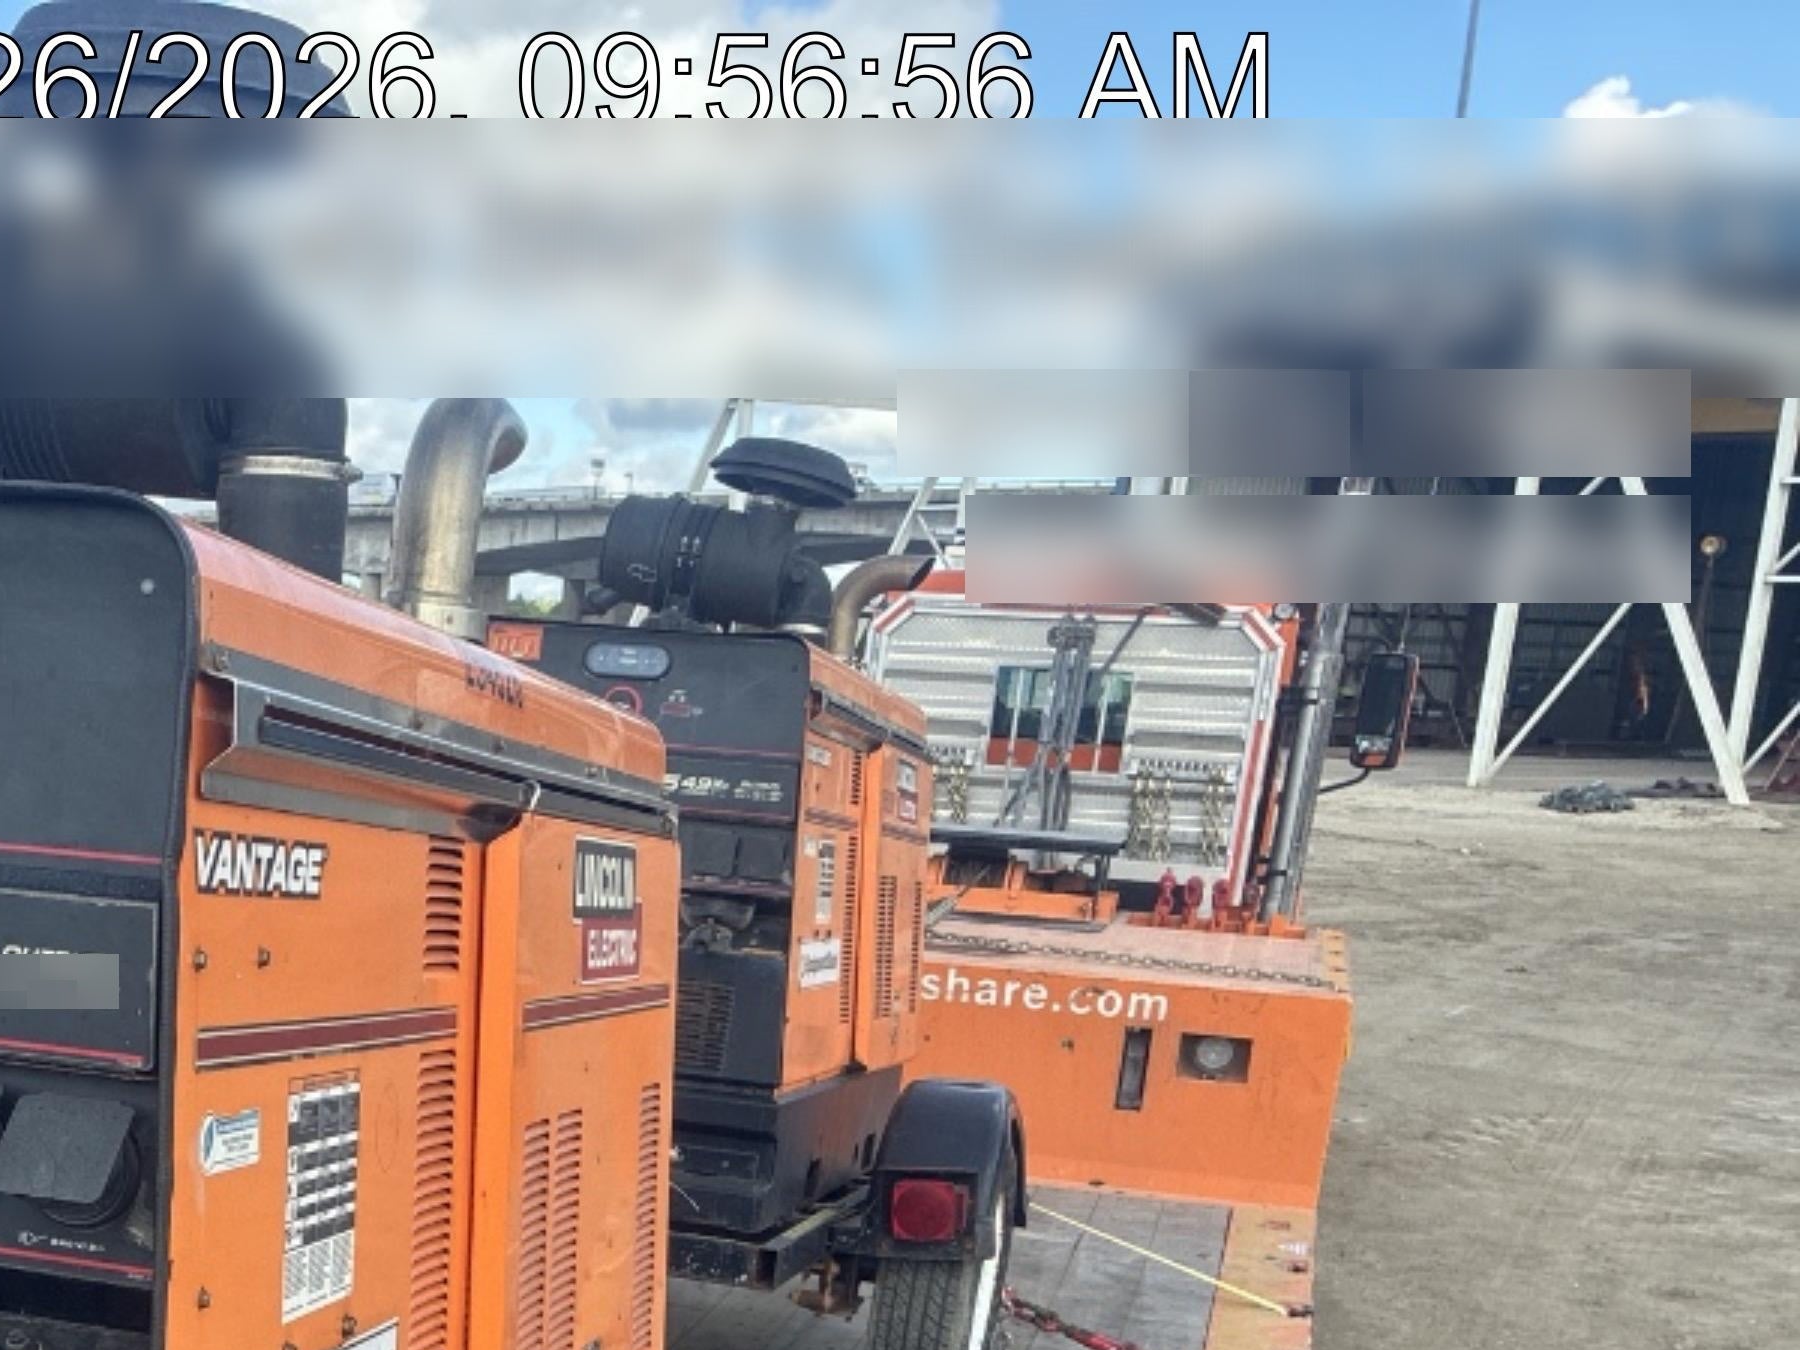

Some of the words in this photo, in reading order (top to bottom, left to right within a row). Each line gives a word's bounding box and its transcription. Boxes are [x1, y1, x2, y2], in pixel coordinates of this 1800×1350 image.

[194, 835, 324, 896] VANTAGE
[576, 852, 635, 910] LINCOLN
[588, 928, 638, 969] ELECTRIC
